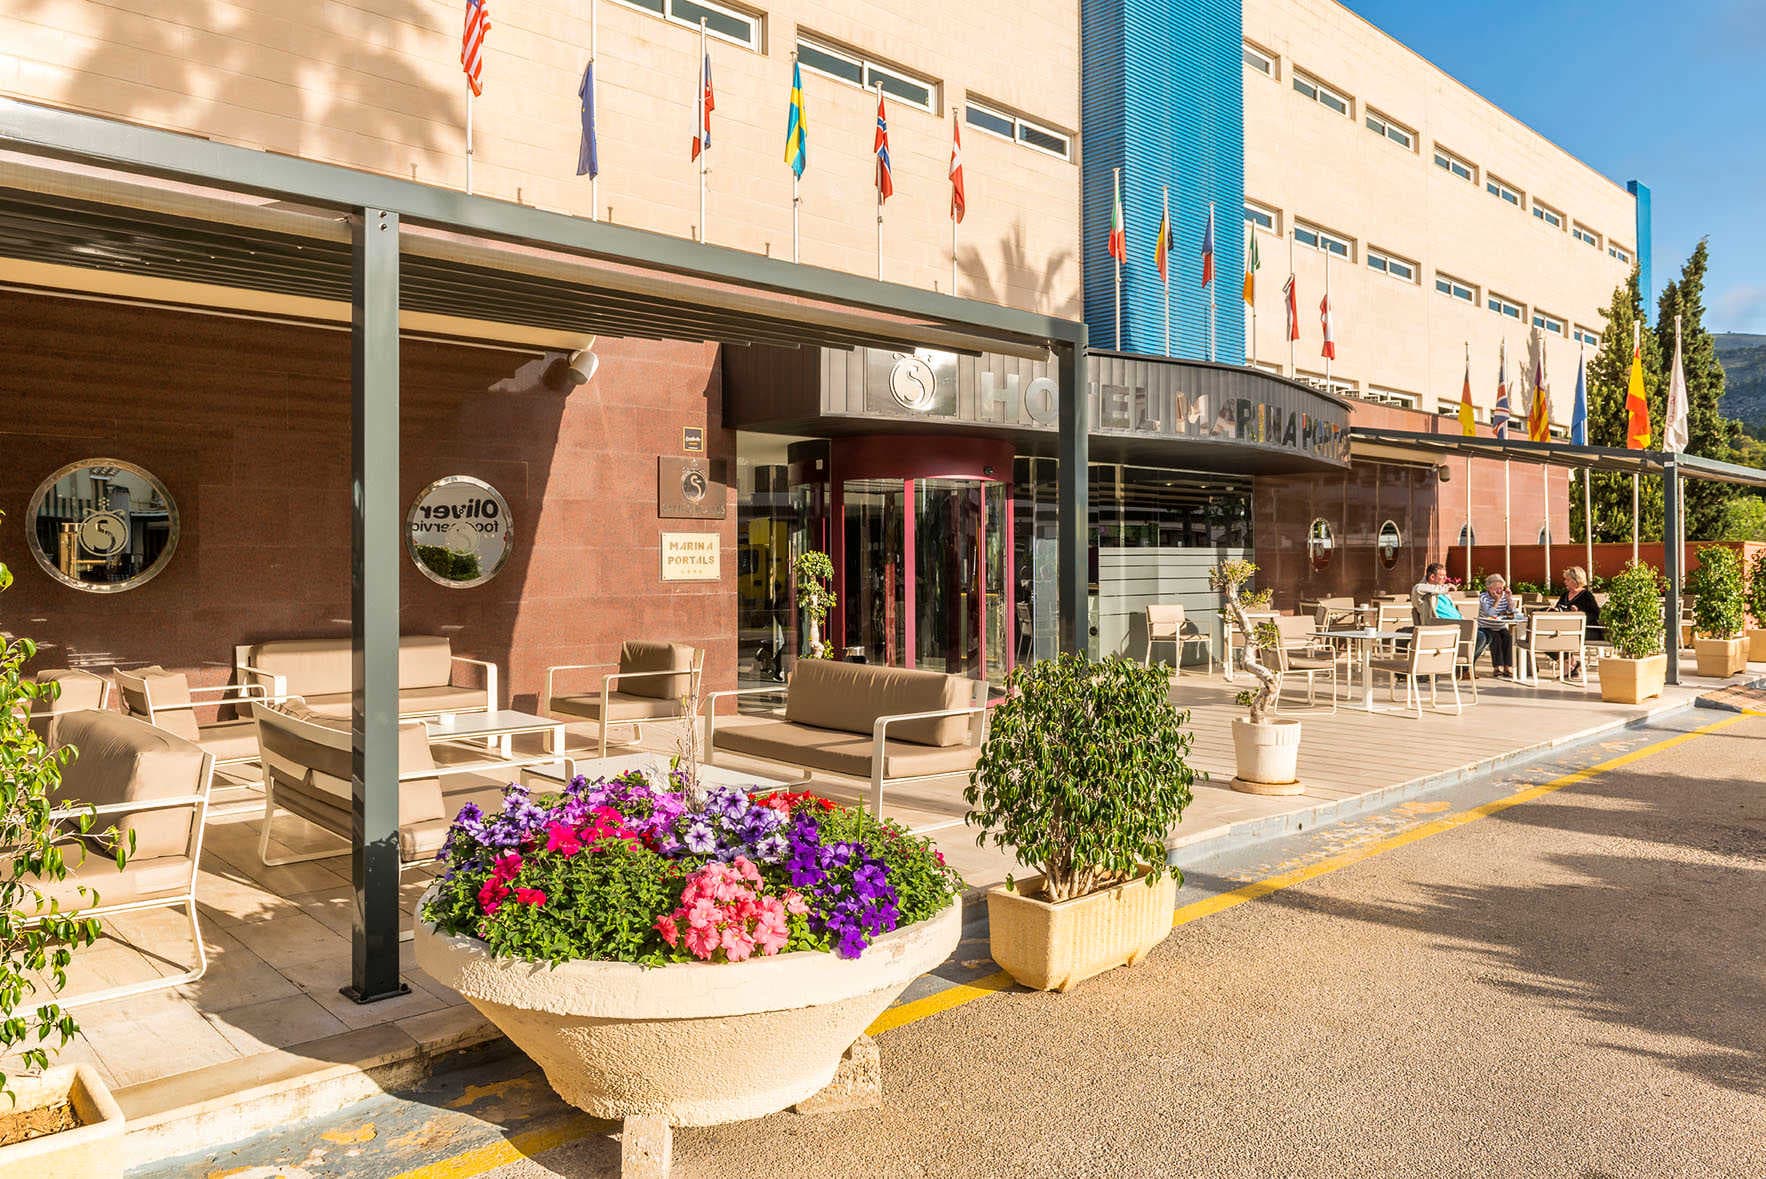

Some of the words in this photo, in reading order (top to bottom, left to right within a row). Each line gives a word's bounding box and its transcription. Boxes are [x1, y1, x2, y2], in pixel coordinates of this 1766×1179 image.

[980, 371, 1161, 434] HOEL
[1174, 391, 1297, 447] MARINA
[669, 541, 714, 551] MARINA
[667, 555, 715, 566] PORTALS
